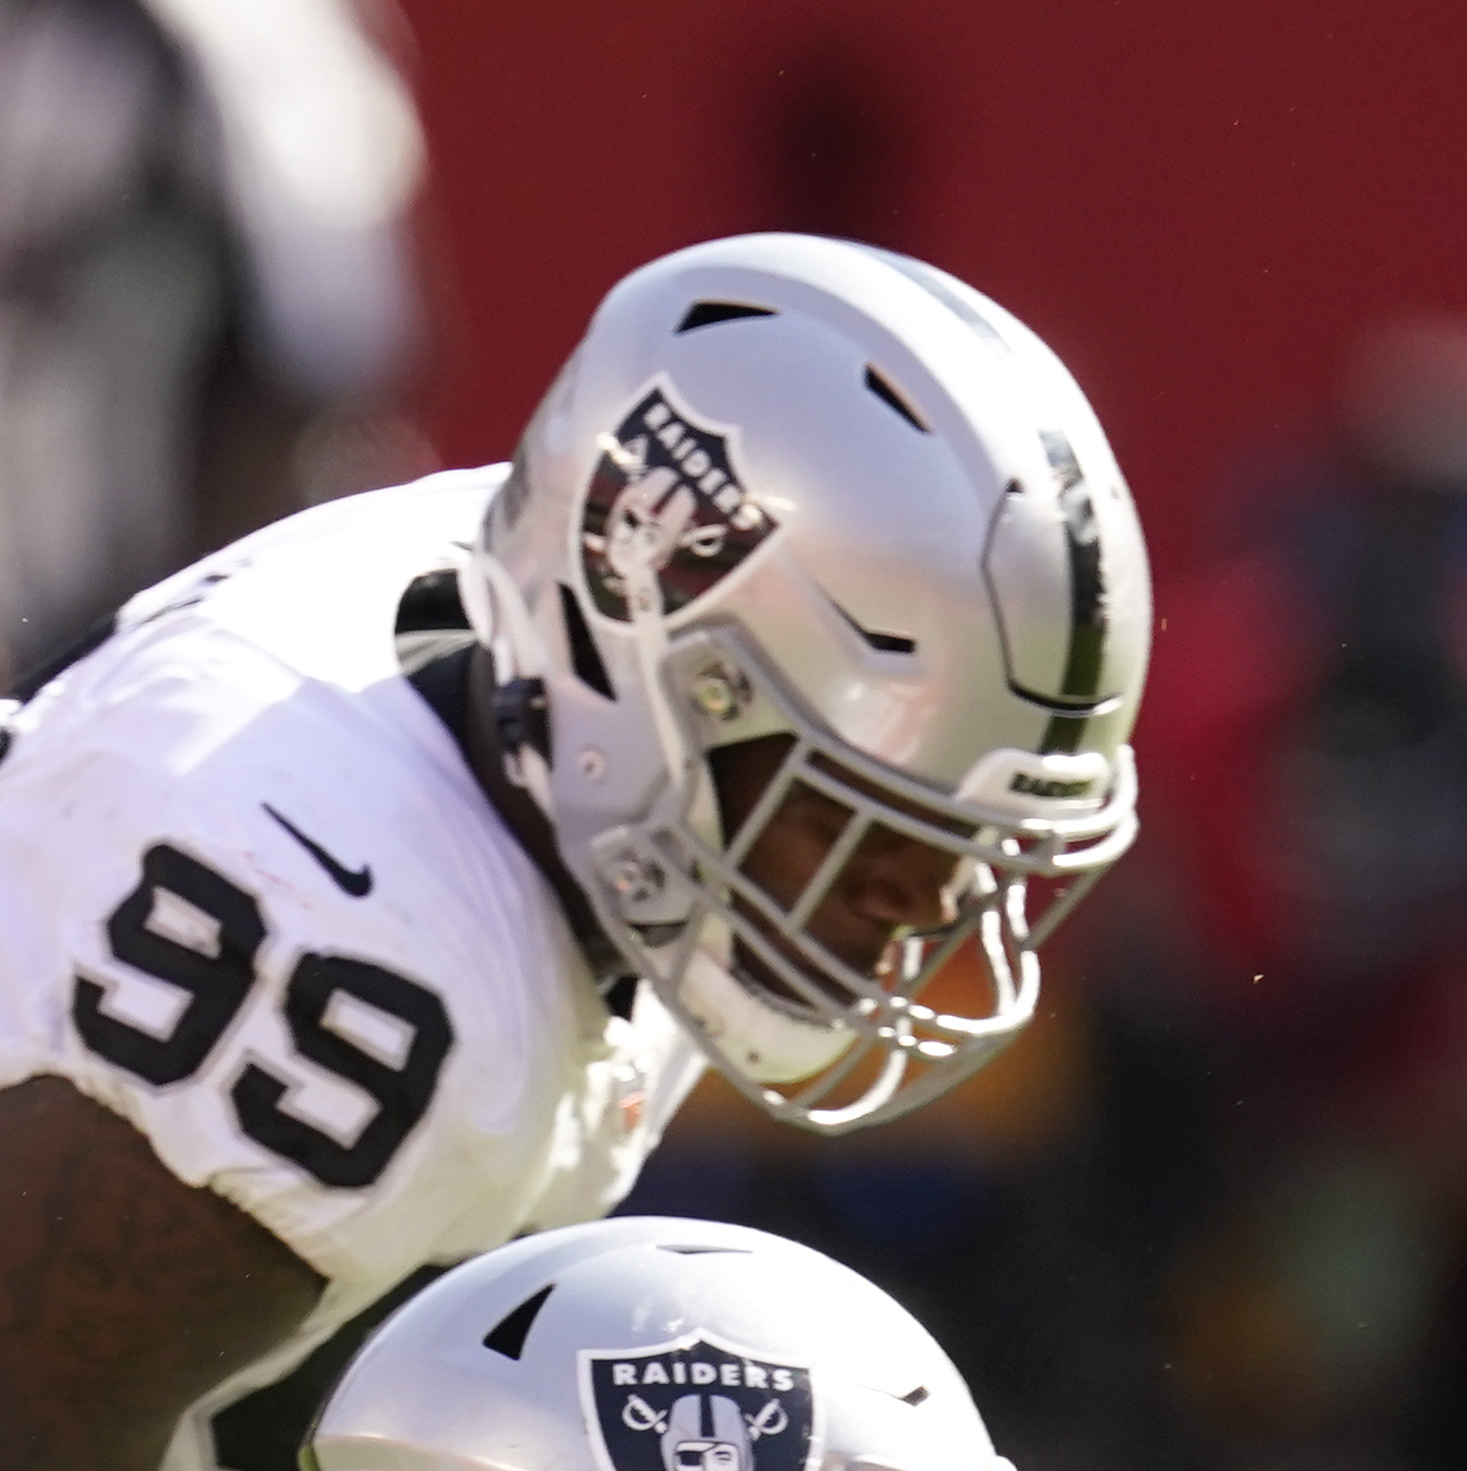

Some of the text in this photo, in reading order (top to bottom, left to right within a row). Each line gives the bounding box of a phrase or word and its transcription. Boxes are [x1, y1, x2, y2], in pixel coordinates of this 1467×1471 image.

[642, 402, 764, 532] RAIDERS
[71, 841, 456, 1190] 99
[612, 1361, 795, 1392] RAIDERS
